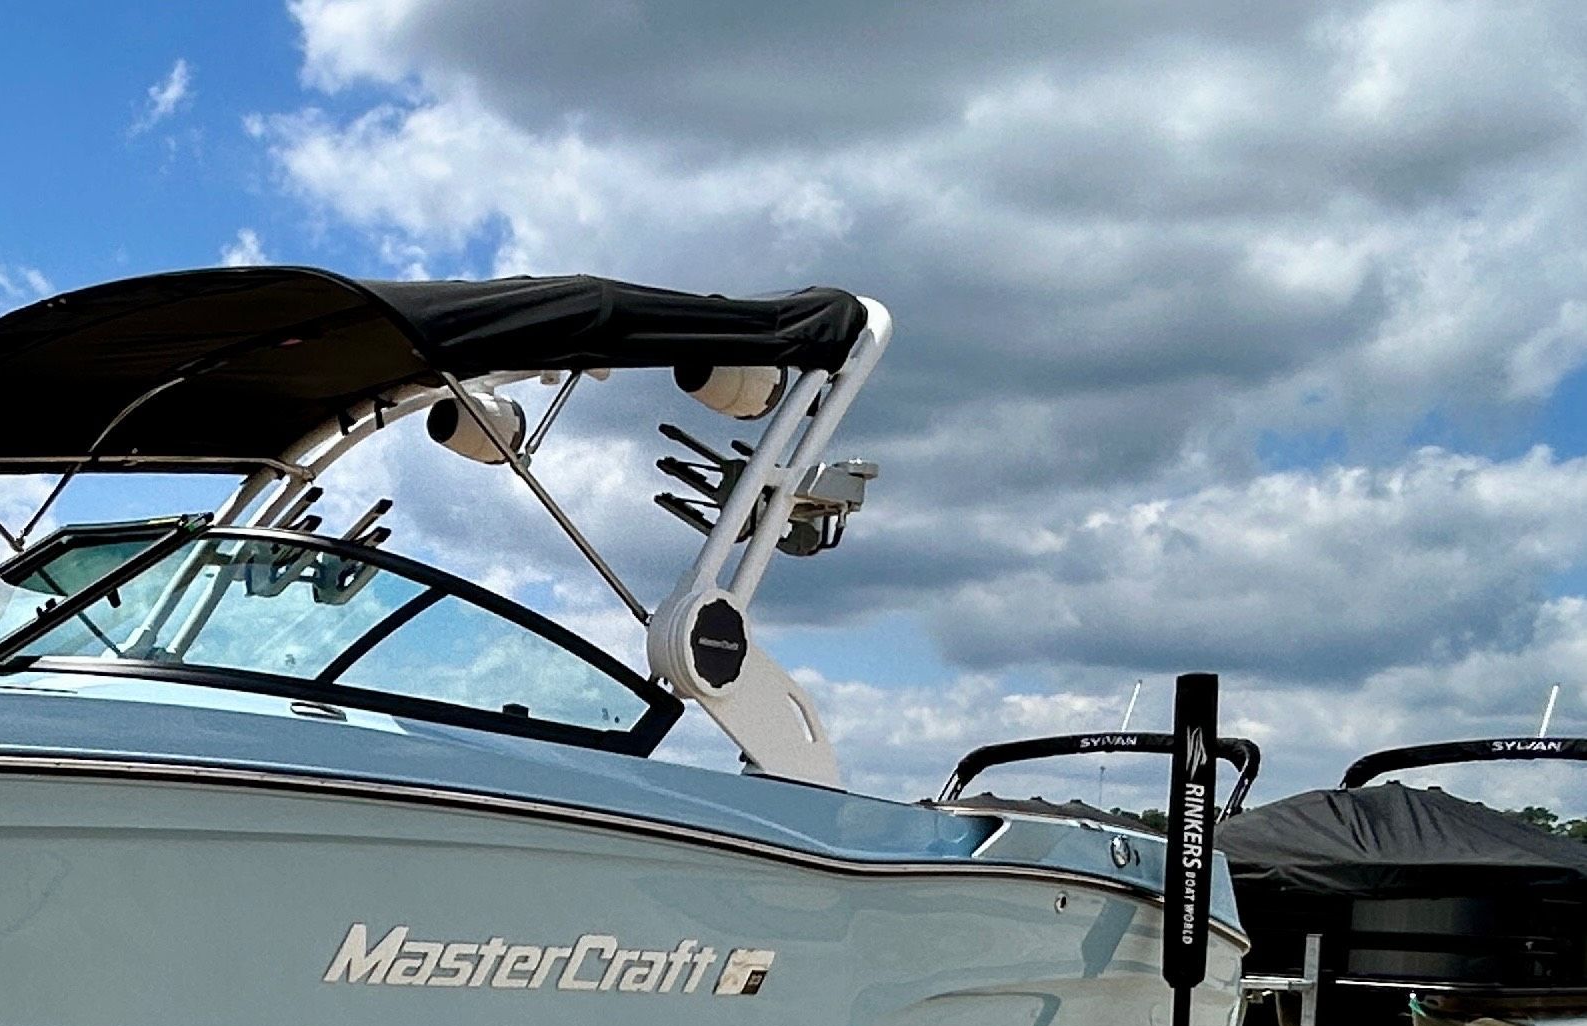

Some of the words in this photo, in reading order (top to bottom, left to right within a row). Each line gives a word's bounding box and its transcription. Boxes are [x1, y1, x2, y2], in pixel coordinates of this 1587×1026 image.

[1491, 741, 1562, 752] SYLVAN
[1182, 782, 1205, 870] RINKERS
[1184, 871, 1196, 901] BOAT
[1182, 903, 1195, 945] WORLD
[323, 922, 717, 994] MasterCraft
